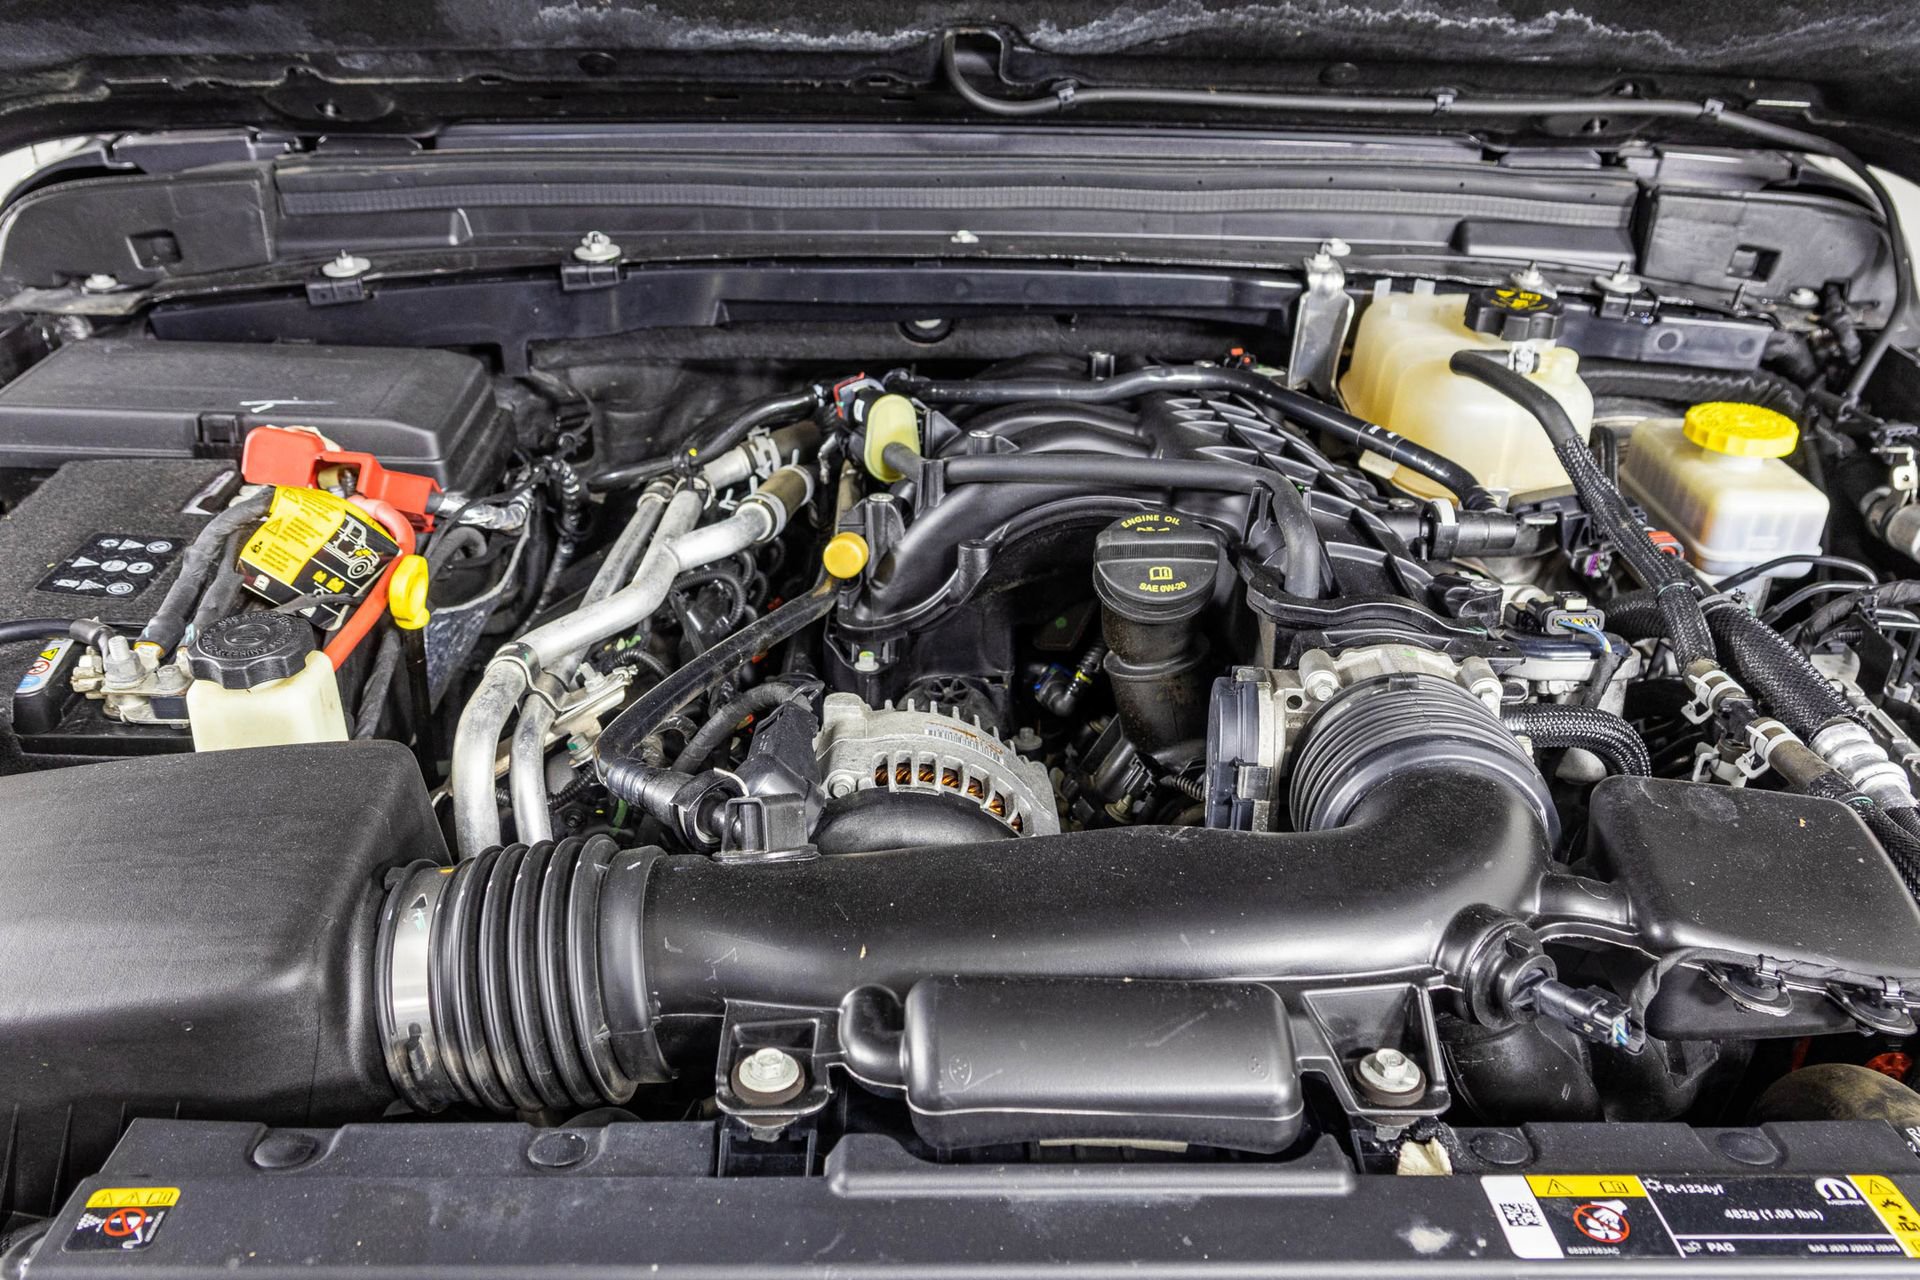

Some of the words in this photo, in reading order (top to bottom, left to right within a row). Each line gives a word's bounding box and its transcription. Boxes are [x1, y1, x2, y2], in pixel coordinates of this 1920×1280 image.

[1121, 514, 1160, 529] ENGINE
[1164, 515, 1181, 526] OIL
[1139, 582, 1159, 593] SAE
[1160, 581, 1187, 593] 0W-20
[1724, 1208, 1760, 1221] 482g
[1706, 1242, 1736, 1253] PAG
